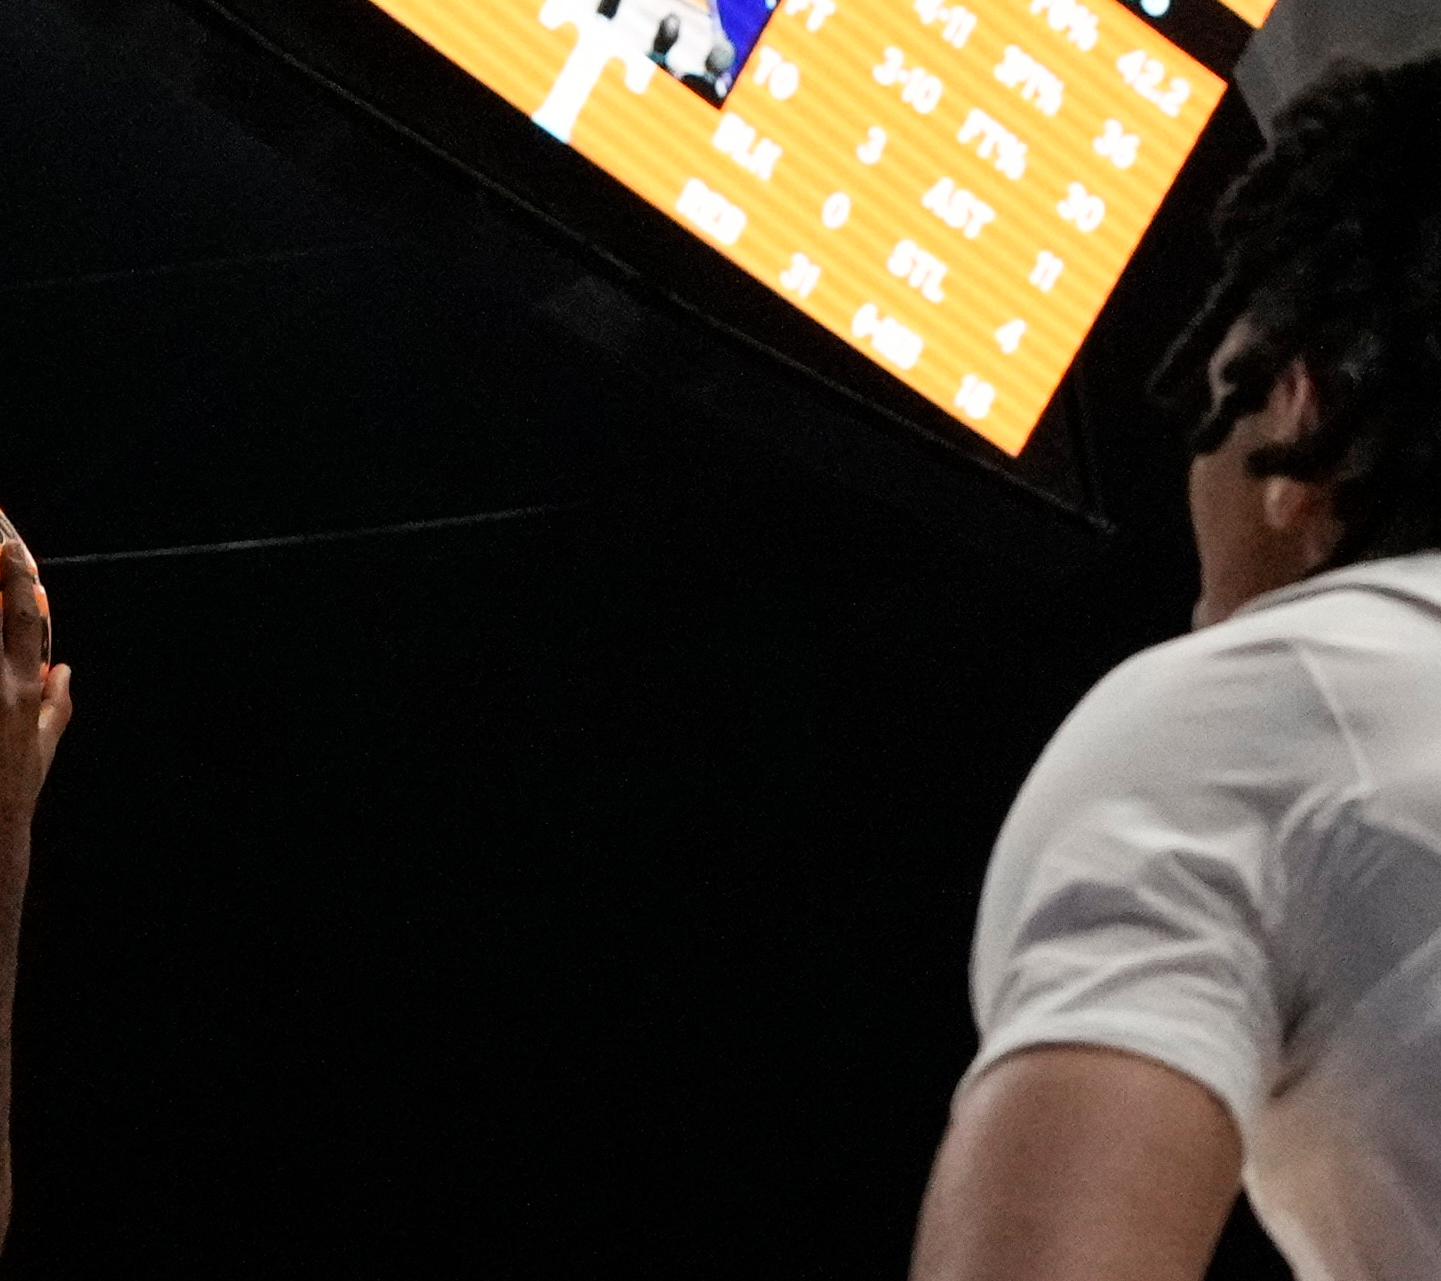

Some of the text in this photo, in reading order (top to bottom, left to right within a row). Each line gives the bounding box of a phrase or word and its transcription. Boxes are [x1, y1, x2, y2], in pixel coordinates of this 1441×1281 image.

[1116, 49, 1192, 118] 42.2
[753, 45, 1064, 293] TO 3 AST 11
[872, 46, 943, 115] 3-10
[1057, 181, 1106, 234] 30
[1093, 118, 1141, 170] 36
[779, 252, 822, 298] 31
[887, 239, 948, 304] STL
[994, 317, 1027, 355] 4
